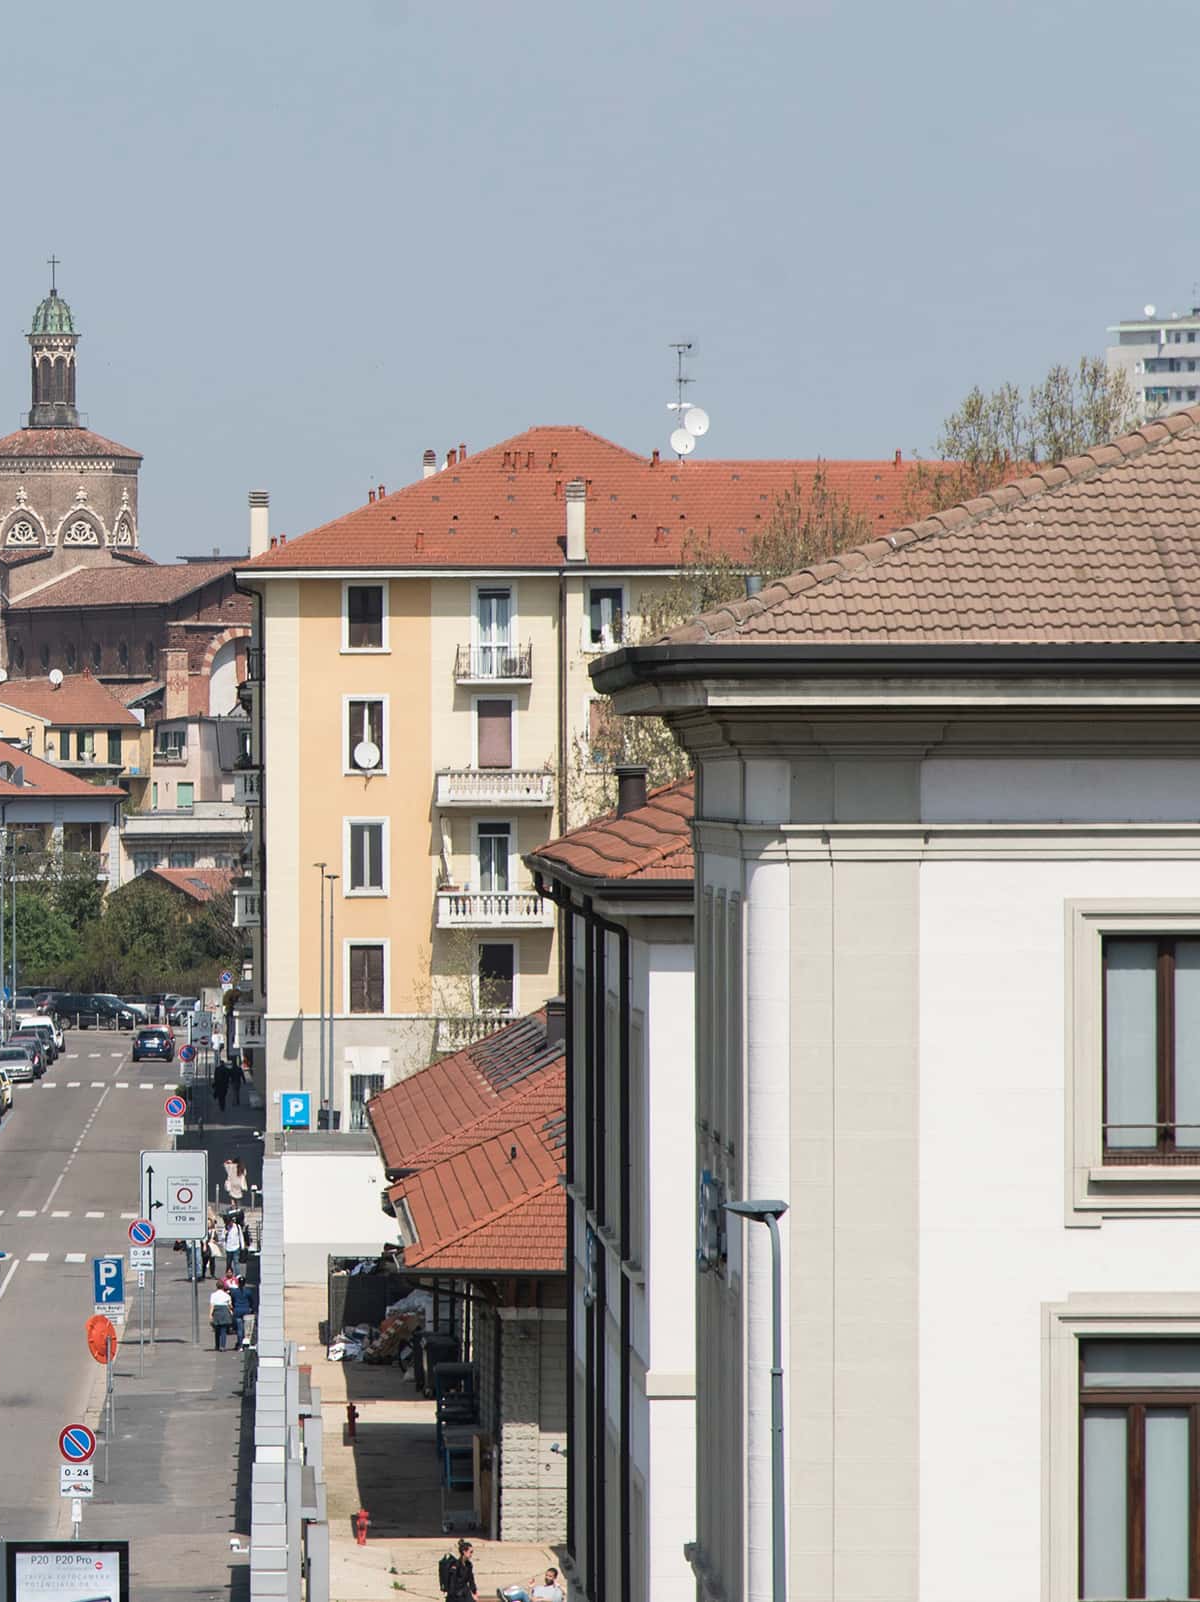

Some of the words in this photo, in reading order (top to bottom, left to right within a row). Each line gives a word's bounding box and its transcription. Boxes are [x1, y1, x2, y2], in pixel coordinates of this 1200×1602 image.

[290, 1101, 303, 1117] P
[100, 1263, 117, 1286] P
[31, 1555, 49, 1565] P20
[55, 1555, 74, 1565] P20
[76, 1555, 92, 1565] Pro
